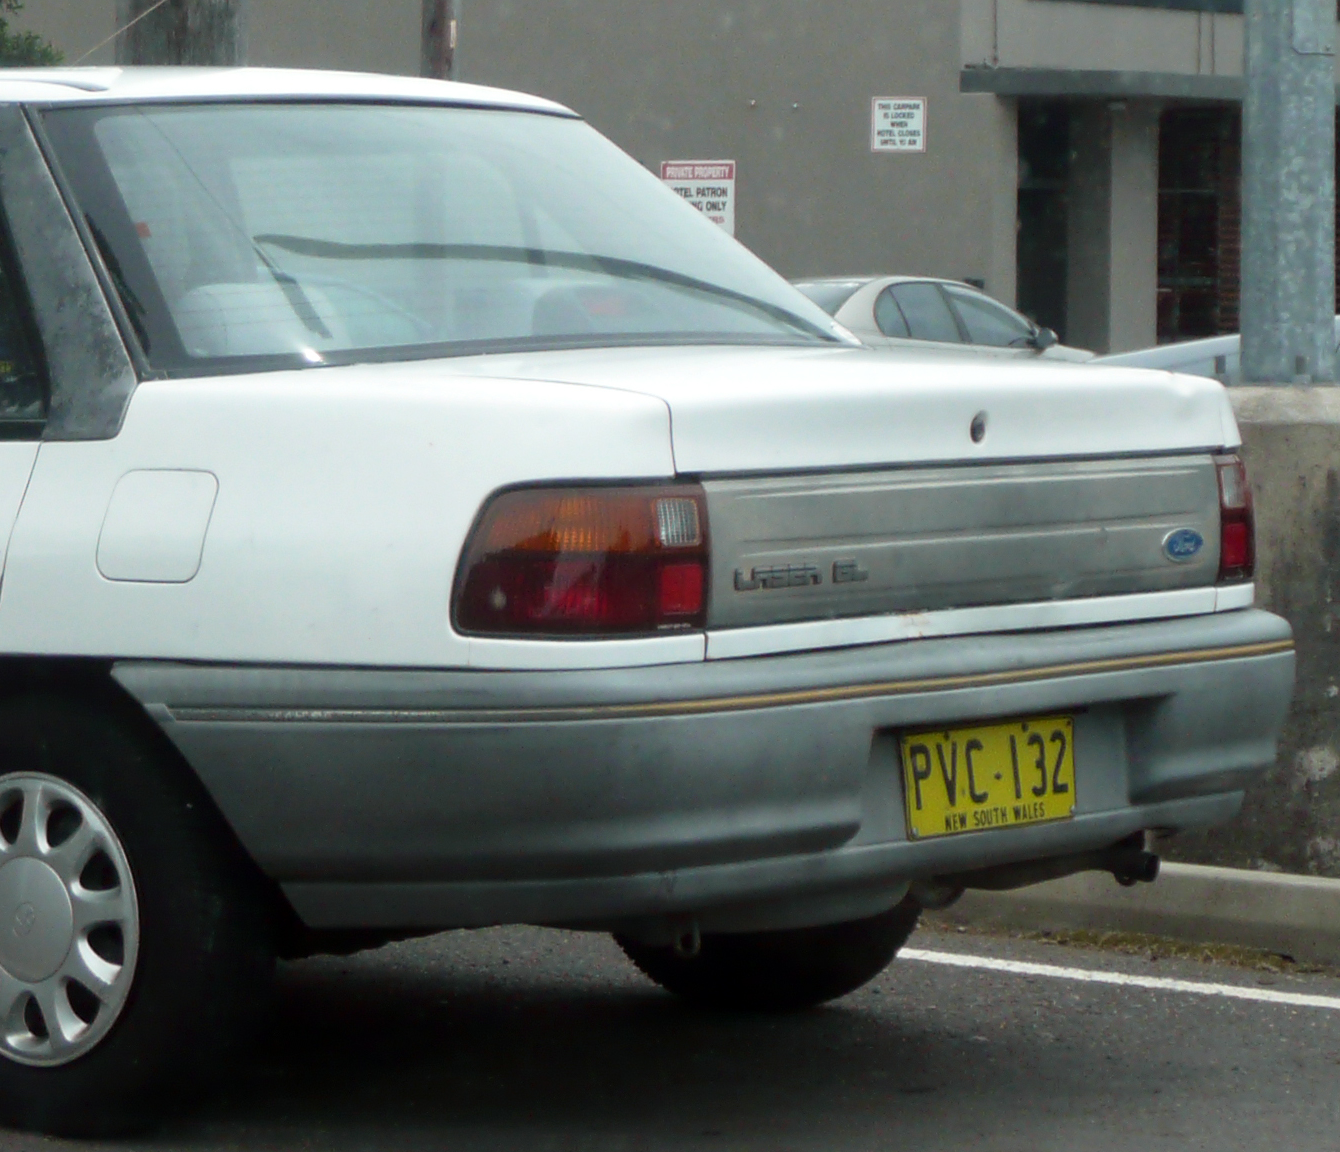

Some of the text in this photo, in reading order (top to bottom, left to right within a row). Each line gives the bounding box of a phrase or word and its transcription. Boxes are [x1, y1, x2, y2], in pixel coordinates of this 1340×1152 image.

[666, 166, 730, 178] PRIVATE PROPERTY
[672, 187, 728, 198] OTEL PATRON
[706, 201, 727, 211] ONLY
[944, 802, 1046, 832] NEW SOUTH WALES
